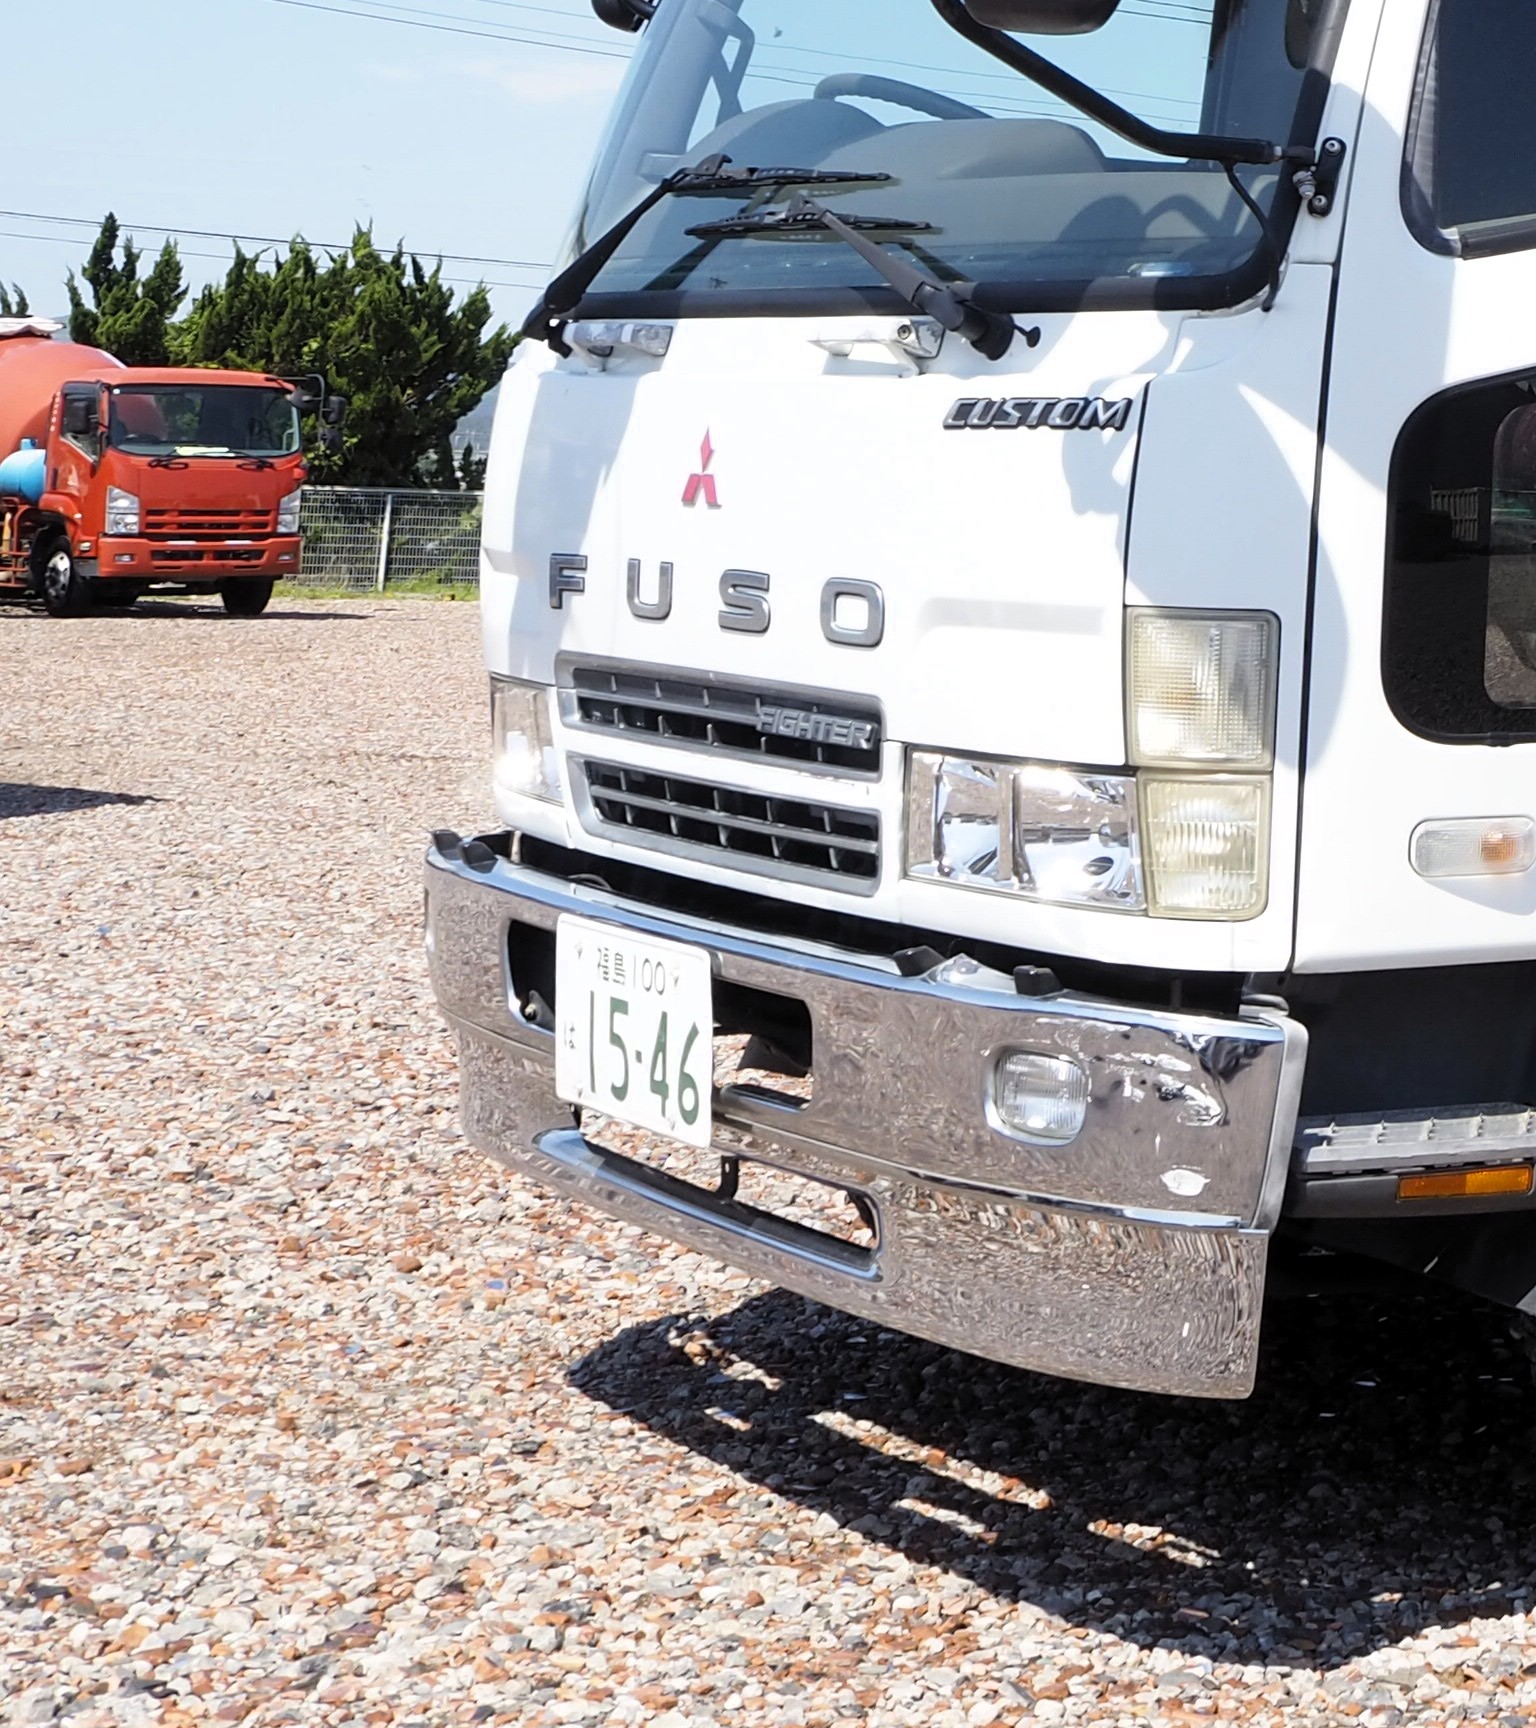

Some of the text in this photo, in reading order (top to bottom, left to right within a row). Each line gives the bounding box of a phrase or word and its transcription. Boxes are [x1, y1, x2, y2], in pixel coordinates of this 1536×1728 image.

[942, 397, 1133, 432] CUSTOM
[548, 553, 886, 648] FUSO
[755, 705, 876, 750] FIGHTER
[632, 953, 667, 997] 100
